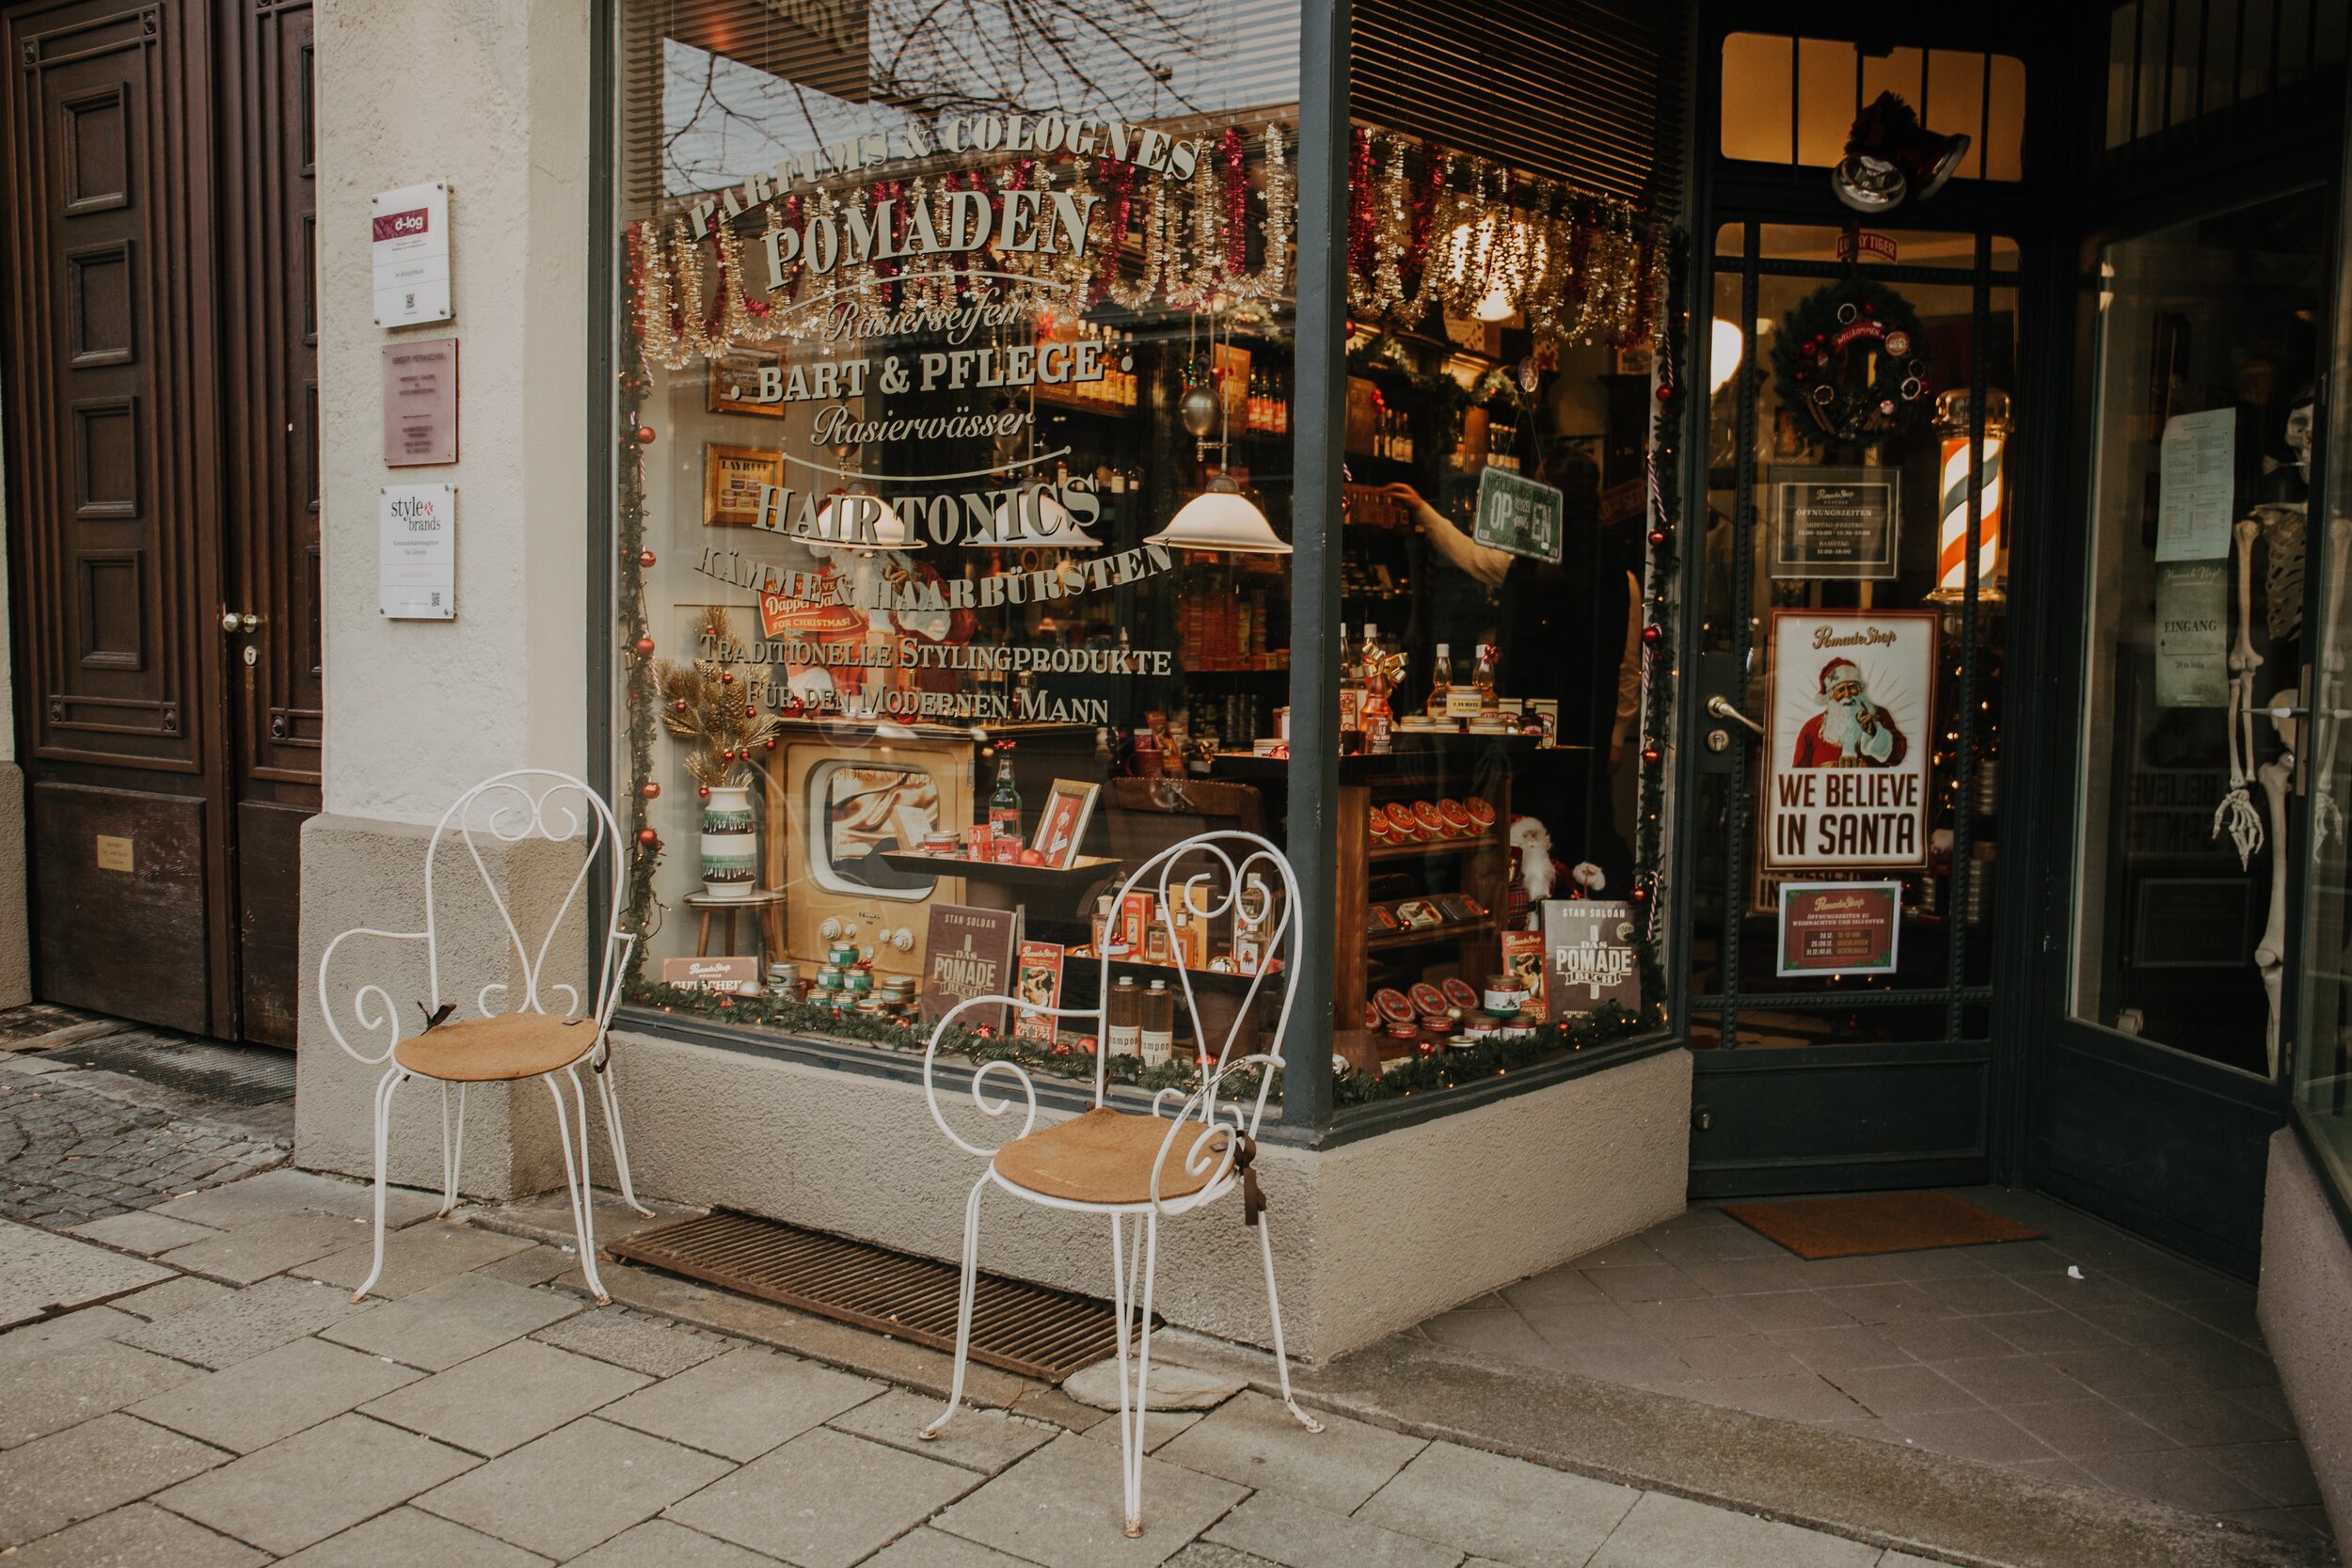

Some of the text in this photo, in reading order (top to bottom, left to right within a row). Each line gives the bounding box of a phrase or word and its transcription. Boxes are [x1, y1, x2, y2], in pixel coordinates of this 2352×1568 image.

[688, 115, 1201, 242] PARFUMS & COLOGNES
[395, 215, 423, 231] d-log
[759, 189, 1100, 292] POMADEN
[1869, 235, 1895, 257] TIGER
[822, 287, 1022, 345] Rasierseifen
[1836, 326, 1881, 345] WILLKOMMEN
[757, 340, 1104, 404] BART & PFLEGE
[810, 405, 1036, 446] Rasierwässer
[391, 497, 423, 521] style
[753, 473, 1102, 546] HAIR TONICS
[1796, 508, 1872, 516] ÖFFNUNGSZEITEN
[409, 516, 441, 531] brands
[693, 537, 1173, 612] KÄMME & HAARBÜRSTEN
[773, 617, 850, 629] FOR CHRISTMAS!
[2165, 620, 2217, 633] EINGANG
[1812, 625, 1897, 649] Pomade Shop
[700, 632, 1172, 678] TRADITIONELLE STYLINGPRODUKTE
[745, 679, 1109, 725] FÜR DEN MODERNEN MANN
[1778, 773, 1919, 807] WE BELIEVE
[1777, 813, 1915, 855] IN SANTA
[945, 913, 996, 929] STAN SOLDAN
[1562, 908, 1626, 919] STAN SOLDAN
[955, 949, 977, 960] DAS
[1581, 941, 1608, 949] DAS
[933, 957, 997, 988] POMADE
[1556, 949, 1632, 972] POMADE
[1575, 973, 1613, 983] BUCH
